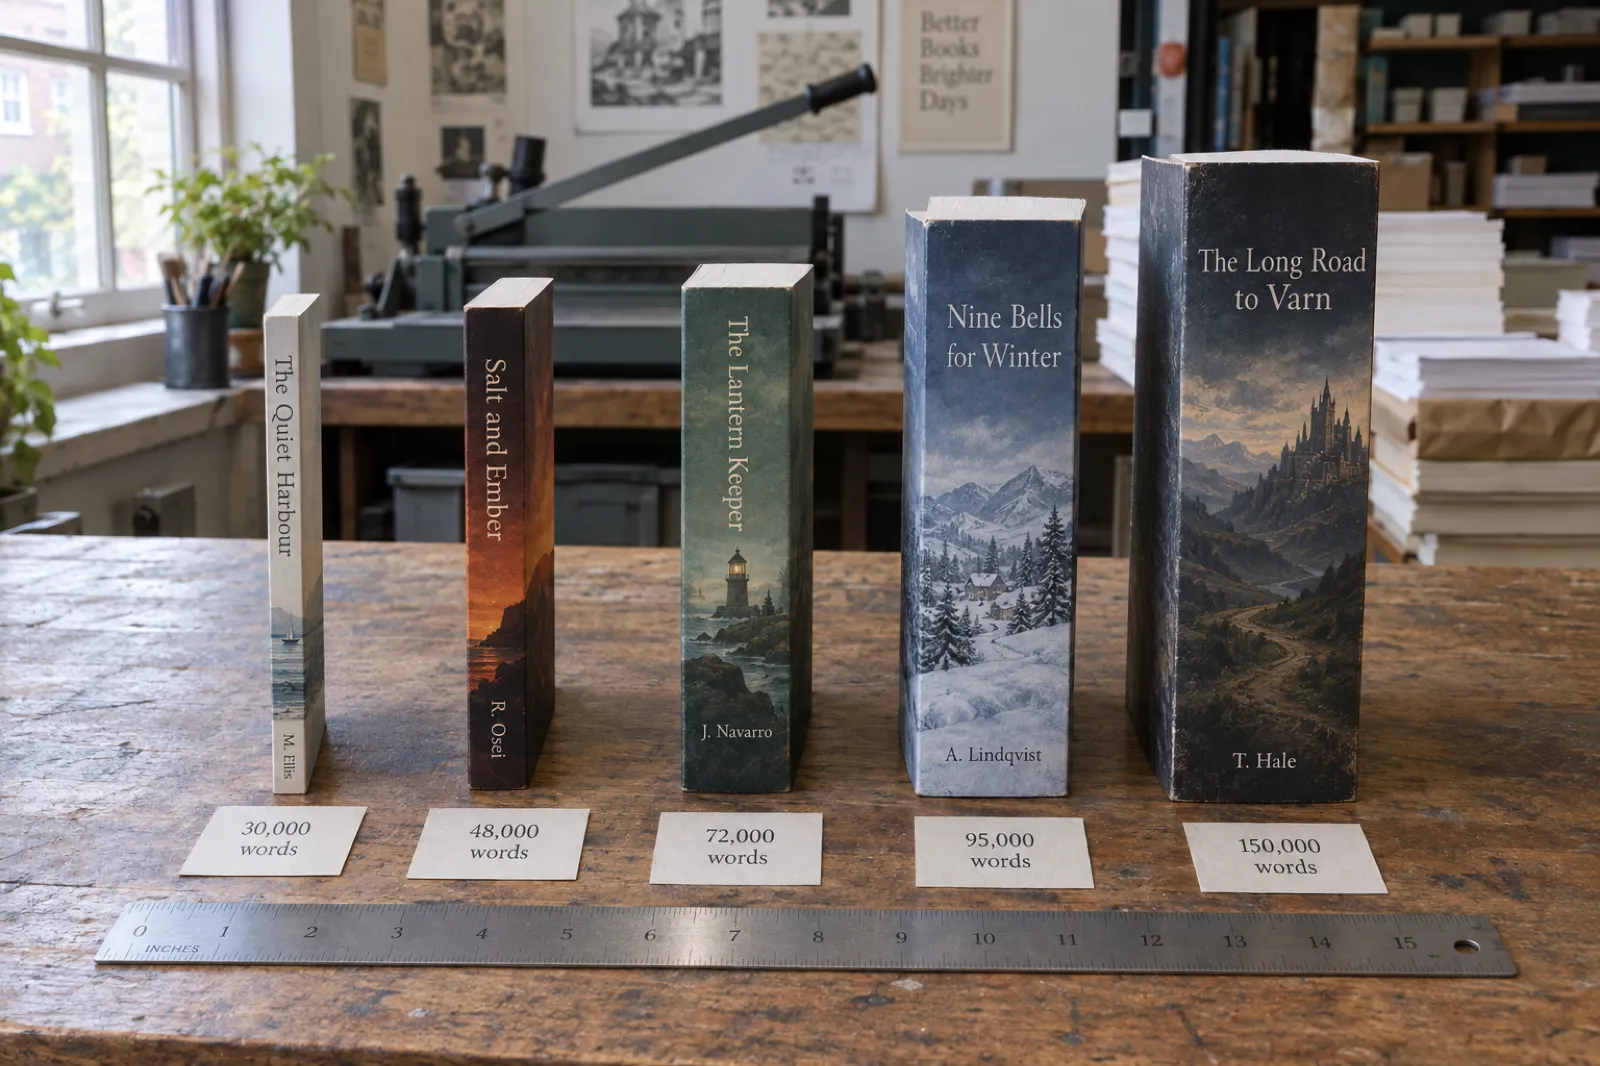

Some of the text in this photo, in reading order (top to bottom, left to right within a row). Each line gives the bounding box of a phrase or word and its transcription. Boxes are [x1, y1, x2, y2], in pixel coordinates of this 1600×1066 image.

[921, 9, 979, 33] Better
[921, 36, 980, 58] Books
[920, 62, 994, 90] Brighter
[920, 88, 969, 116] Days
[1198, 247, 1367, 280] The Long Road
[1234, 283, 1332, 311] to Varn
[947, 302, 1063, 329] Nine Bells
[946, 342, 1062, 368] for Winter
[722, 316, 750, 532] The Lantern Keeper
[271, 355, 296, 557] The Quiet Harbour
[485, 358, 509, 541] Salt and Ember
[491, 700, 507, 759] R. Osei
[701, 724, 773, 741] J. Navarro
[282, 733, 296, 780] M. Ellis
[945, 746, 1043, 766] A. Lindqvist
[1232, 752, 1297, 769] T. Hale
[241, 820, 311, 837] 30,000
[469, 823, 540, 839] 48,000
[706, 828, 775, 845] 72,000
[240, 840, 298, 857] words
[965, 831, 1035, 849] 95,000
[1238, 838, 1321, 856] 150,000
[470, 844, 529, 860] words
[708, 849, 768, 866] words
[970, 852, 1031, 869] words
[1254, 858, 1318, 875] words
[132, 925, 1417, 950] 0 1 2 3 4 5 6 7 8 9 10 11 12 13 14 15
[144, 943, 200, 954] INCHES
